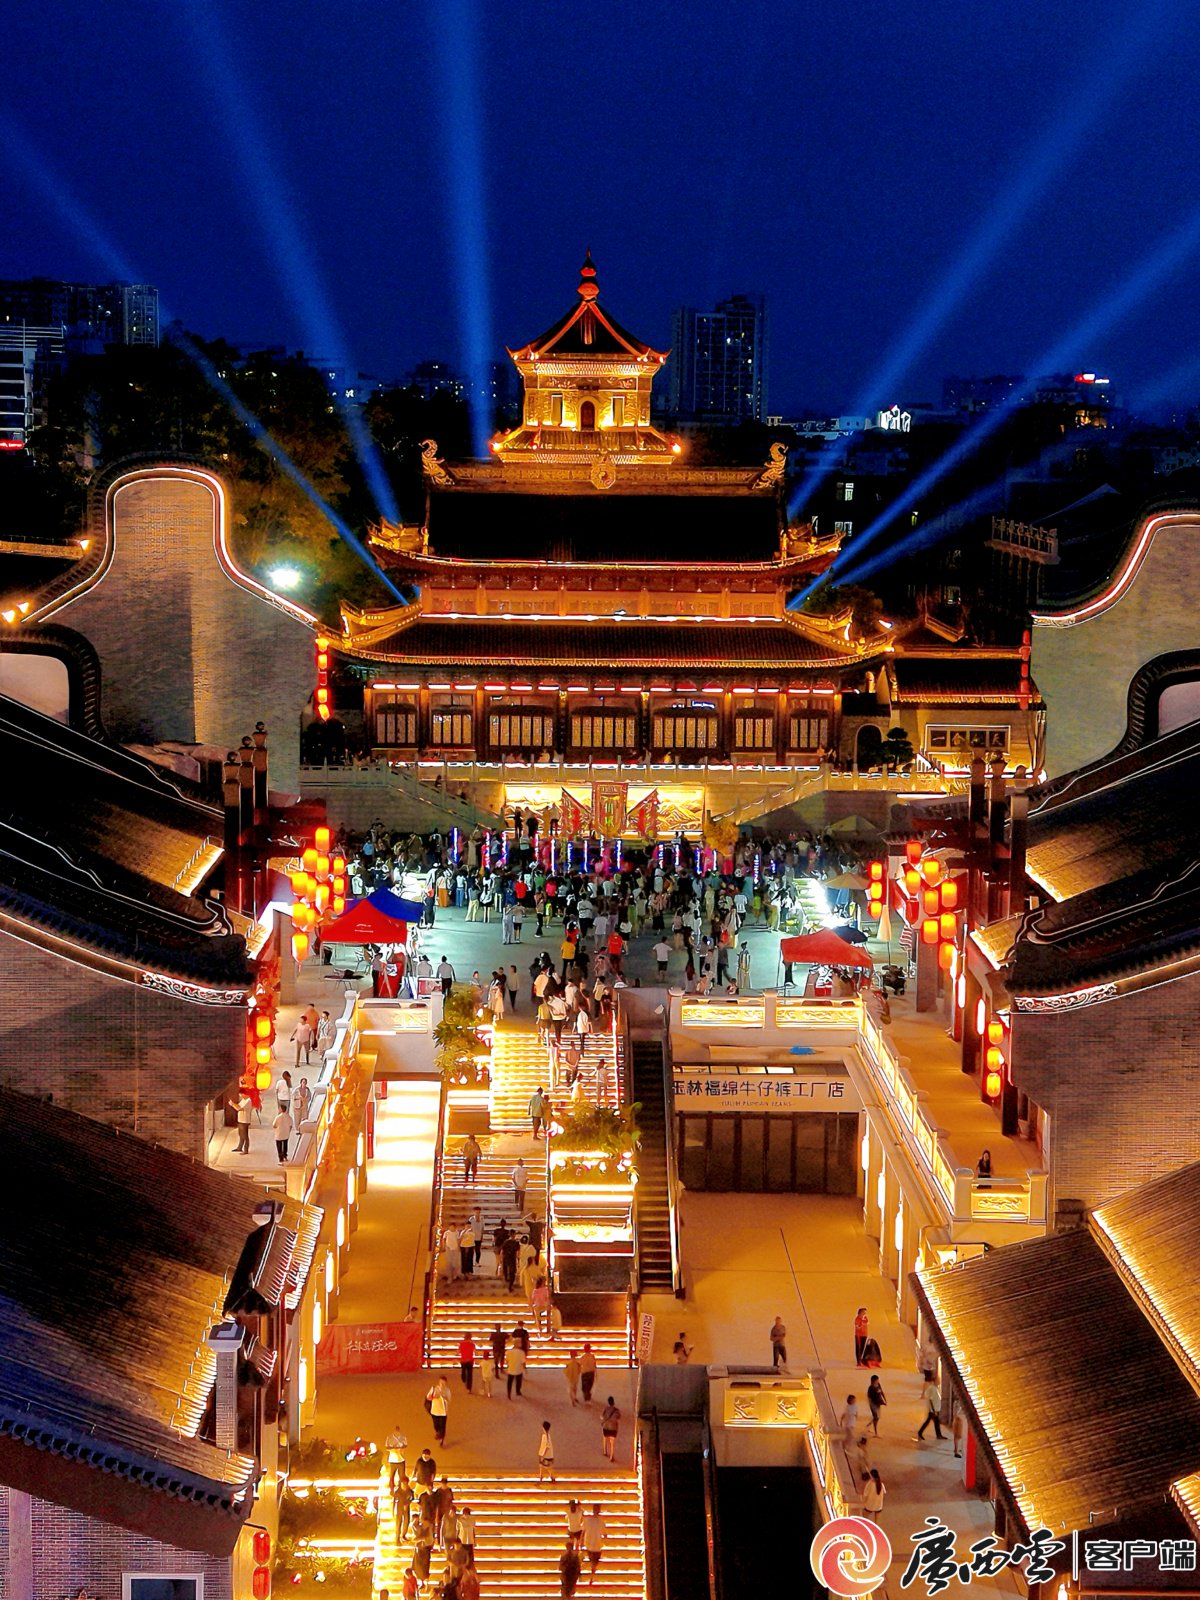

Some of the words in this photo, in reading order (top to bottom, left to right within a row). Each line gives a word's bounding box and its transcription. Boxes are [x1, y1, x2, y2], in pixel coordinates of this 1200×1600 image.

[673, 1080, 845, 1098] 玉林福绵牛仔裤工厂店
